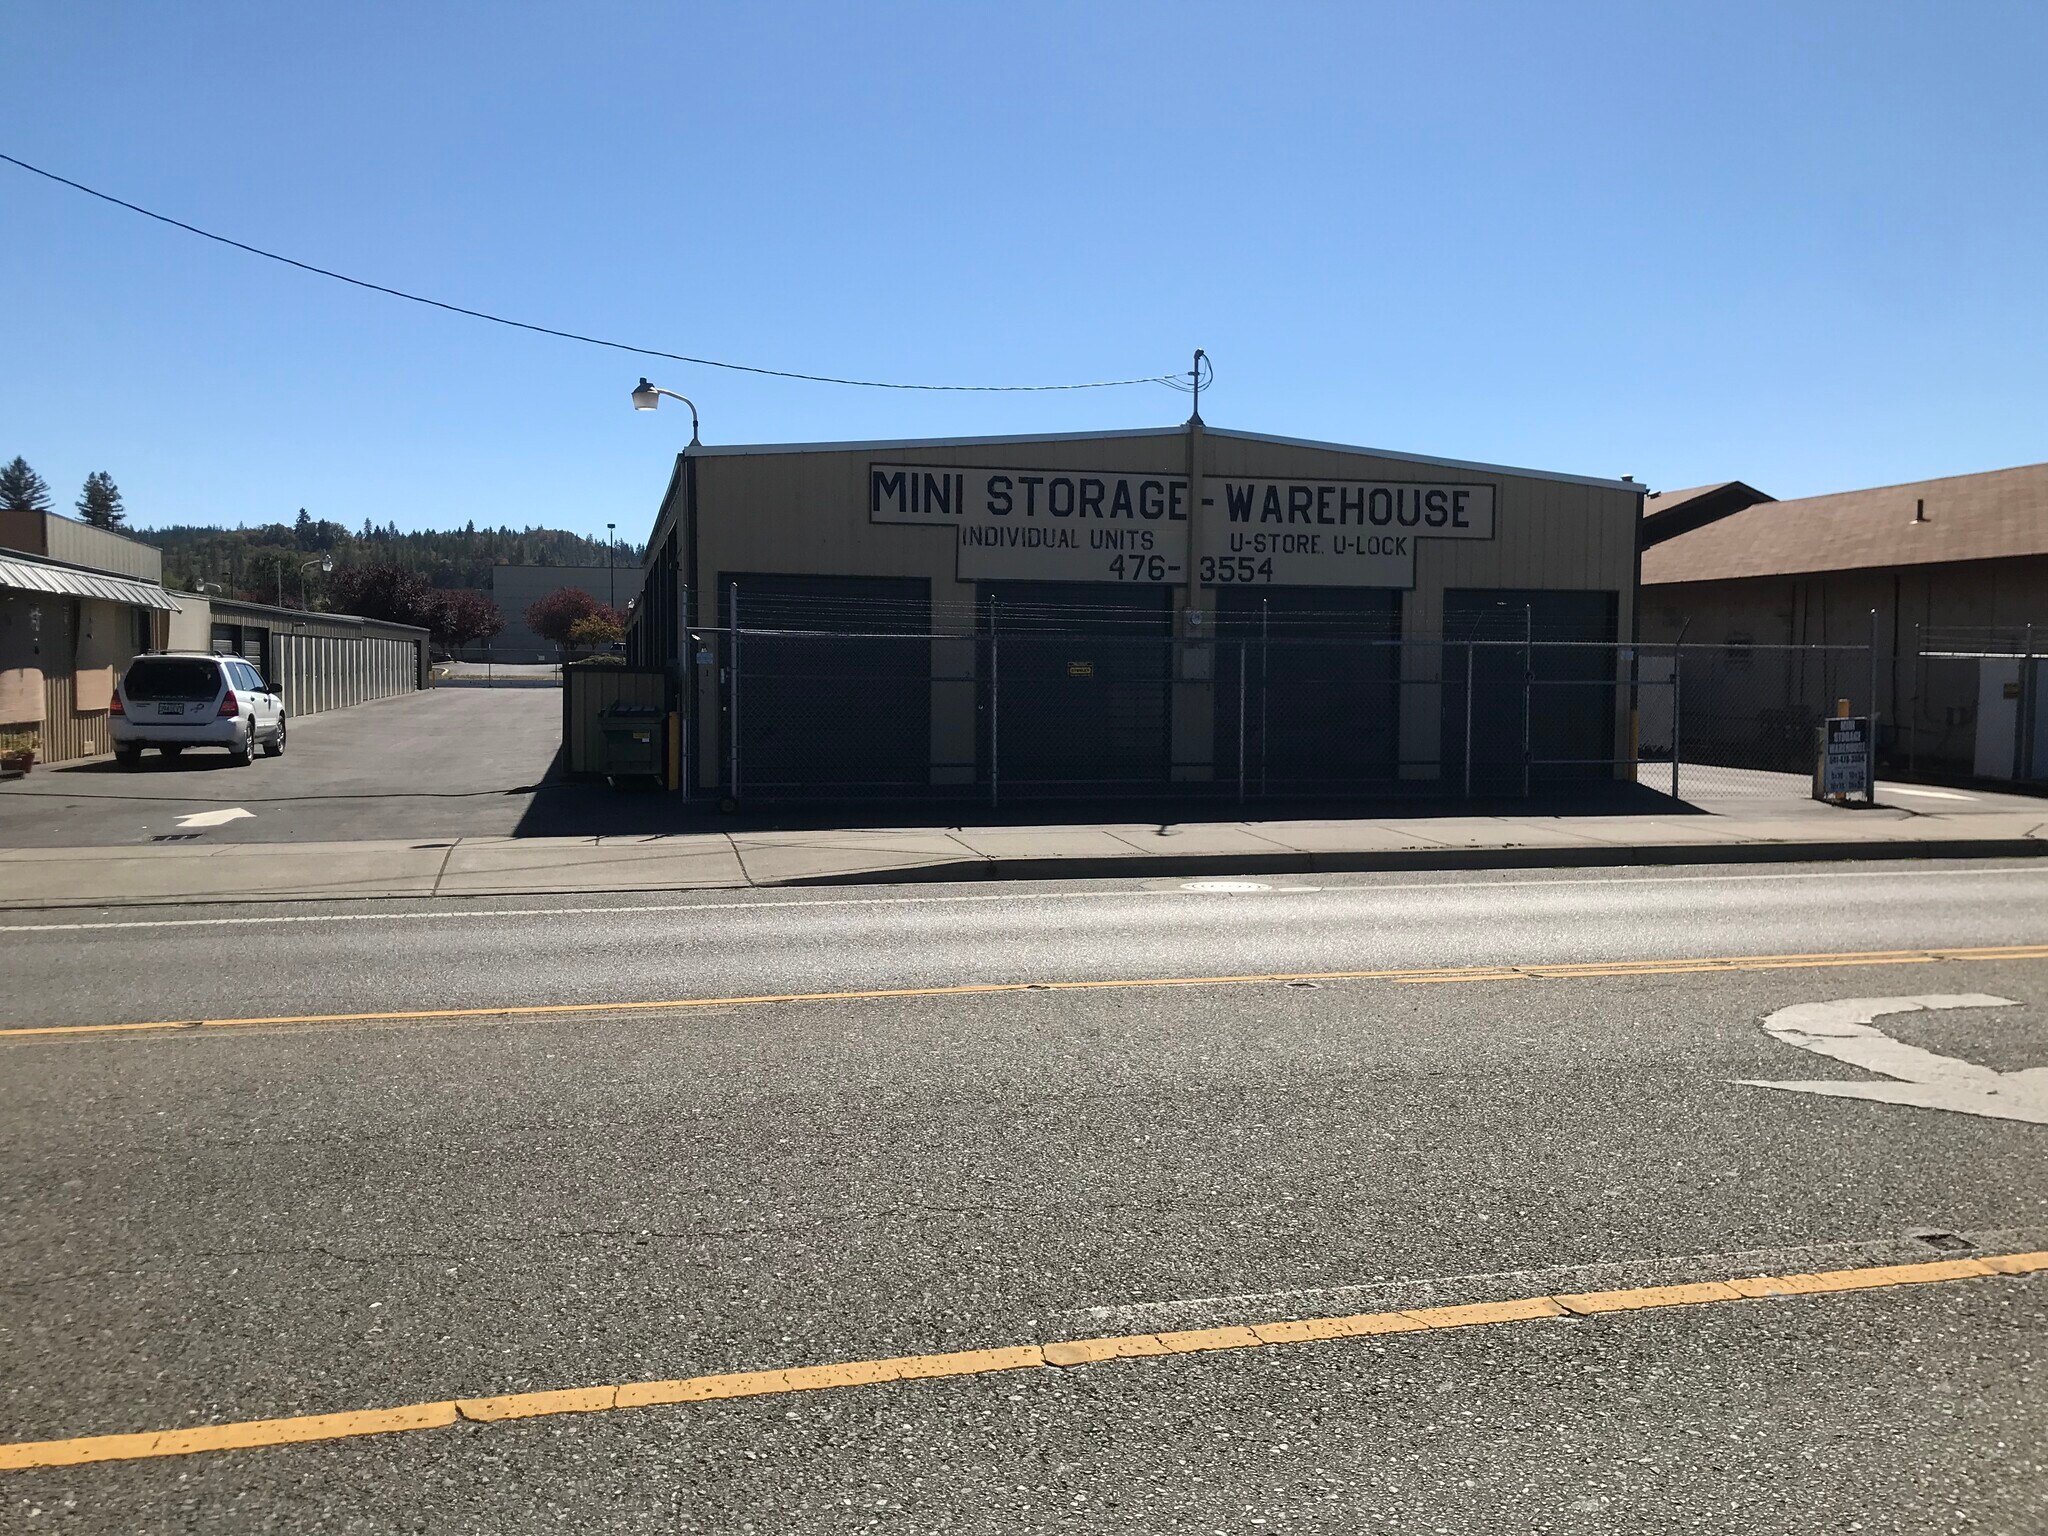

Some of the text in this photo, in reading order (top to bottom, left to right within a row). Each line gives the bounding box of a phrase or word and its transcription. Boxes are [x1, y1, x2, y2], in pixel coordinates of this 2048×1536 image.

[872, 471, 963, 515] MINI
[986, 475, 1187, 520] STORAGE
[1225, 483, 1470, 528] WAREHOUSE
[962, 525, 1154, 551] INDIVIDUAL UNITS
[1333, 535, 1407, 557] U-LOCK
[1199, 556, 1273, 582] 3554
